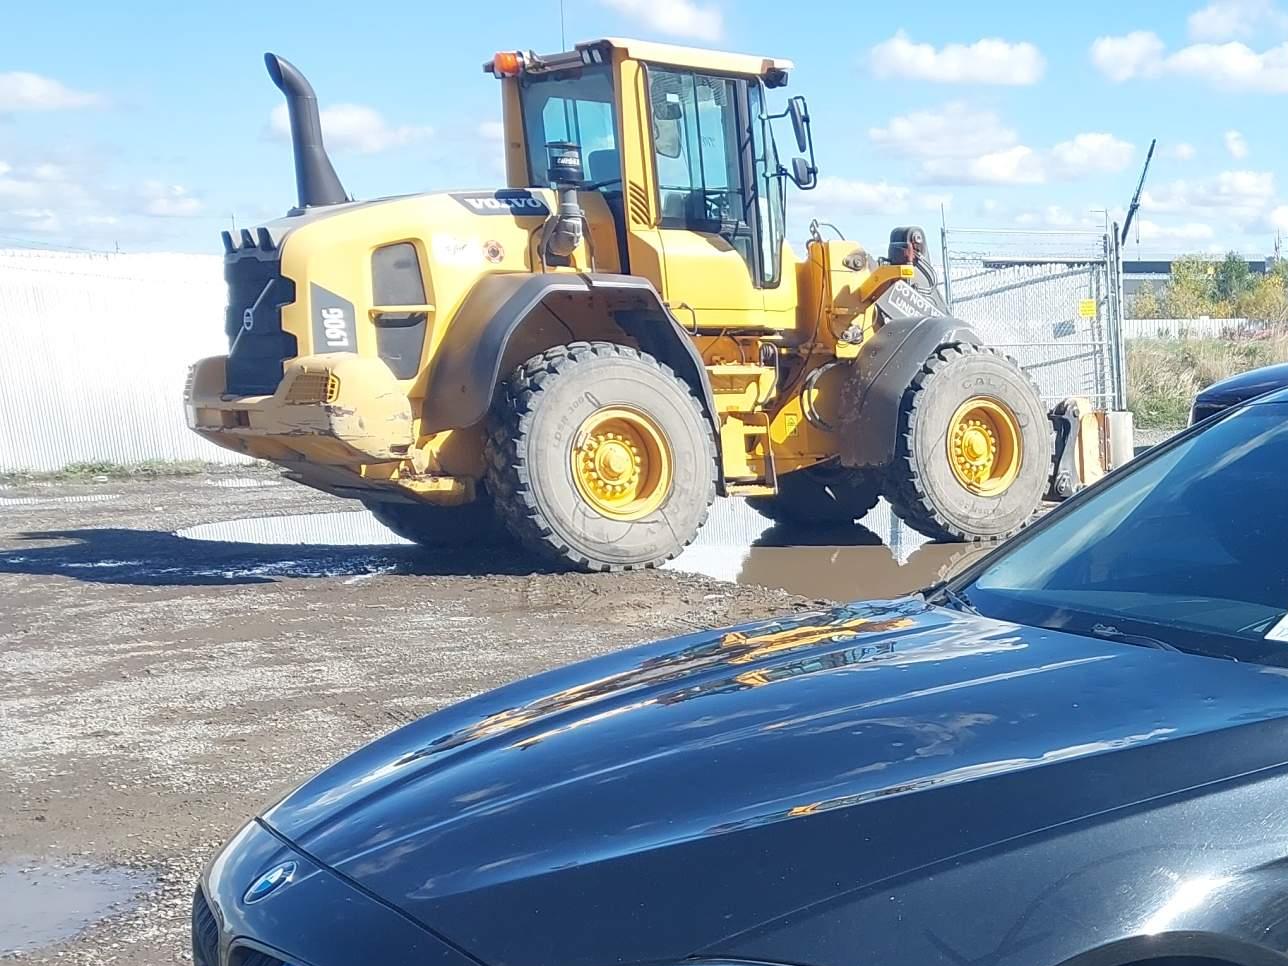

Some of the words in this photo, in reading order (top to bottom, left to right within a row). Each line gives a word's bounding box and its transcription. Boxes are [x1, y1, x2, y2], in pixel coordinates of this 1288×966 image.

[464, 197, 542, 210] VOLVO
[910, 294, 929, 312] NOT
[321, 307, 350, 347] L90G
